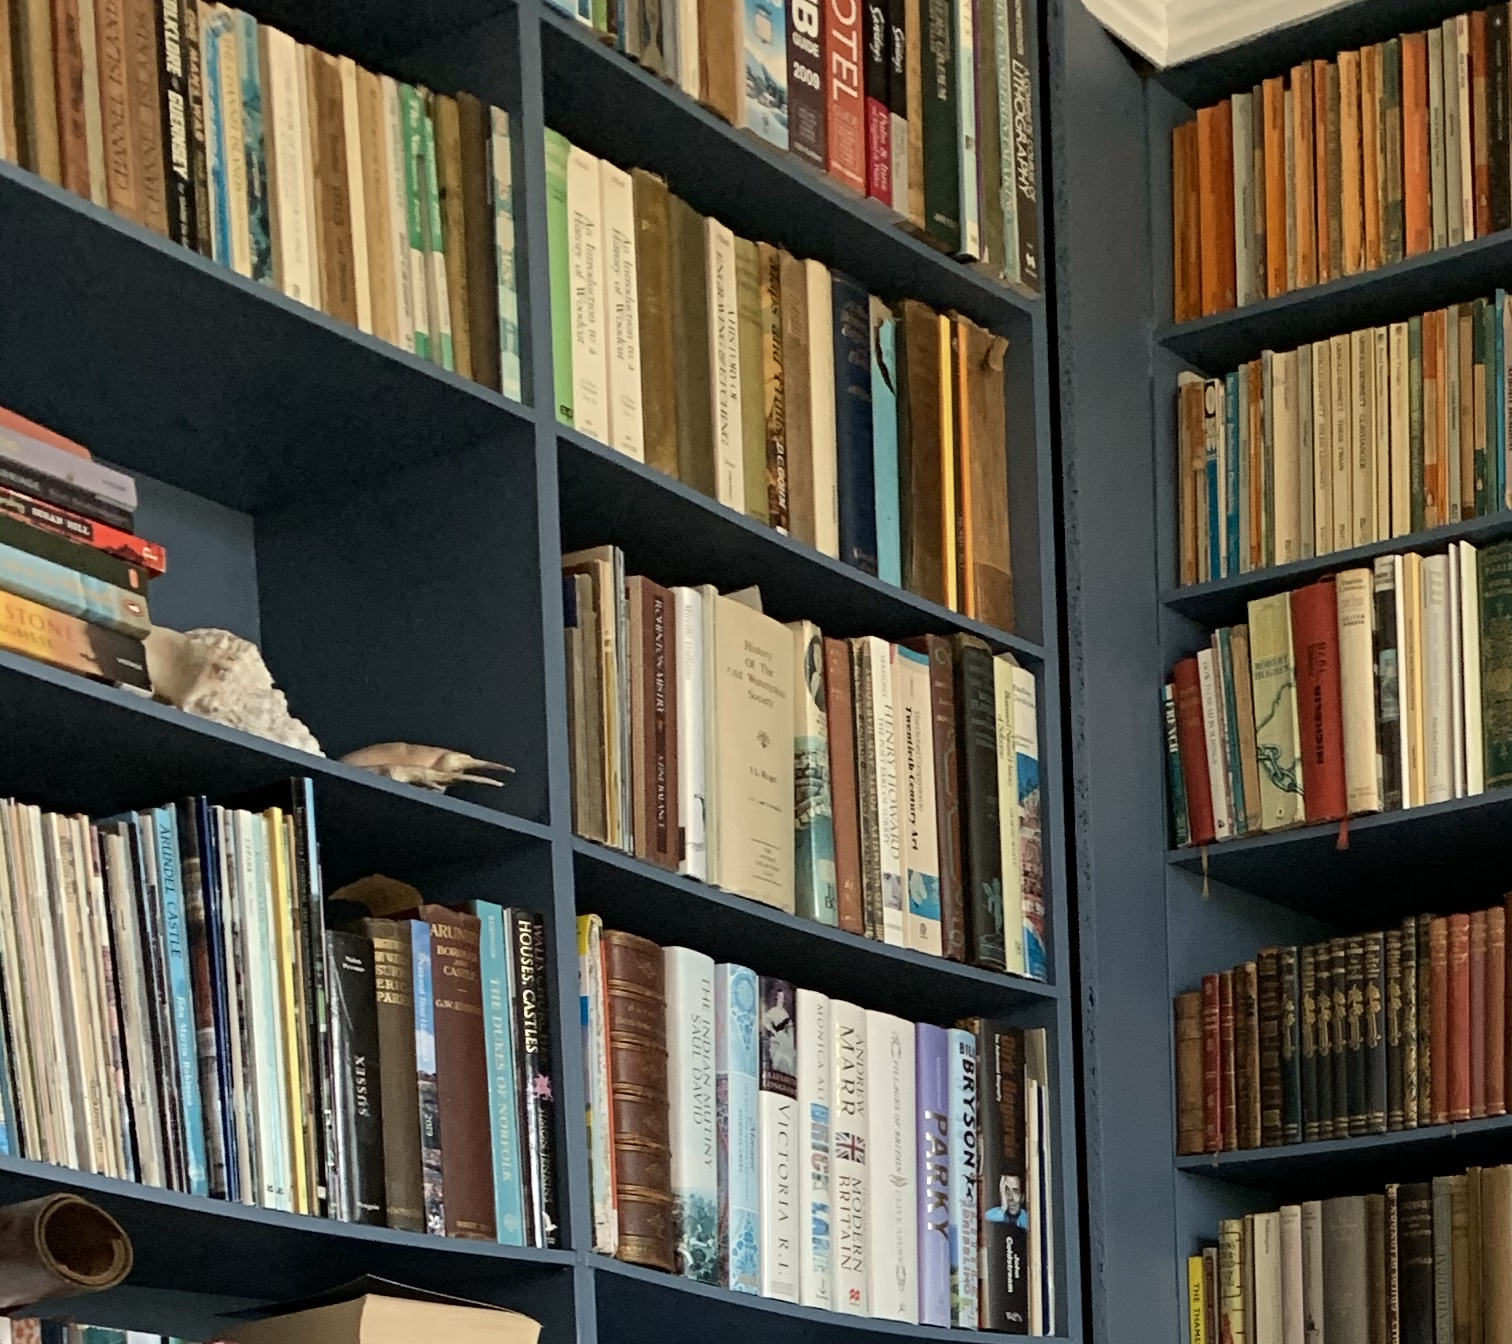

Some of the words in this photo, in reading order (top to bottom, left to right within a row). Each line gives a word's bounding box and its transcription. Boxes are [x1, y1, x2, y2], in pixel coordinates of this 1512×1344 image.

[793, 61, 820, 90] 2009
[168, 90, 189, 181] GUERNSEY
[5, 604, 75, 642] STONE
[1254, 664, 1290, 681] HUGHES
[908, 775, 917, 825] Century
[910, 830, 919, 851] Art
[159, 823, 174, 898] ARUNDEL
[167, 904, 181, 958] CASTLE
[522, 988, 538, 1054] CASTLES
[701, 977, 711, 1014] THE
[691, 1014, 700, 1062] SAUL
[703, 1020, 712, 1088] INDIAN
[816, 1003, 828, 1064] MONICA
[492, 1017, 505, 1072] DUKES
[499, 1102, 513, 1183] NORFOLK
[692, 1069, 703, 1126] DAVID
[839, 1025, 855, 1116] MARR
[855, 1035, 864, 1118] ANDREW
[703, 1093, 713, 1170] MUTINY
[961, 1059, 976, 1168] BRYSON
[778, 1103, 791, 1224] VICTORIA
[925, 1110, 950, 1243] PARKY
[839, 1175, 851, 1271] BRITAIN
[852, 1177, 862, 1273] MODERN
